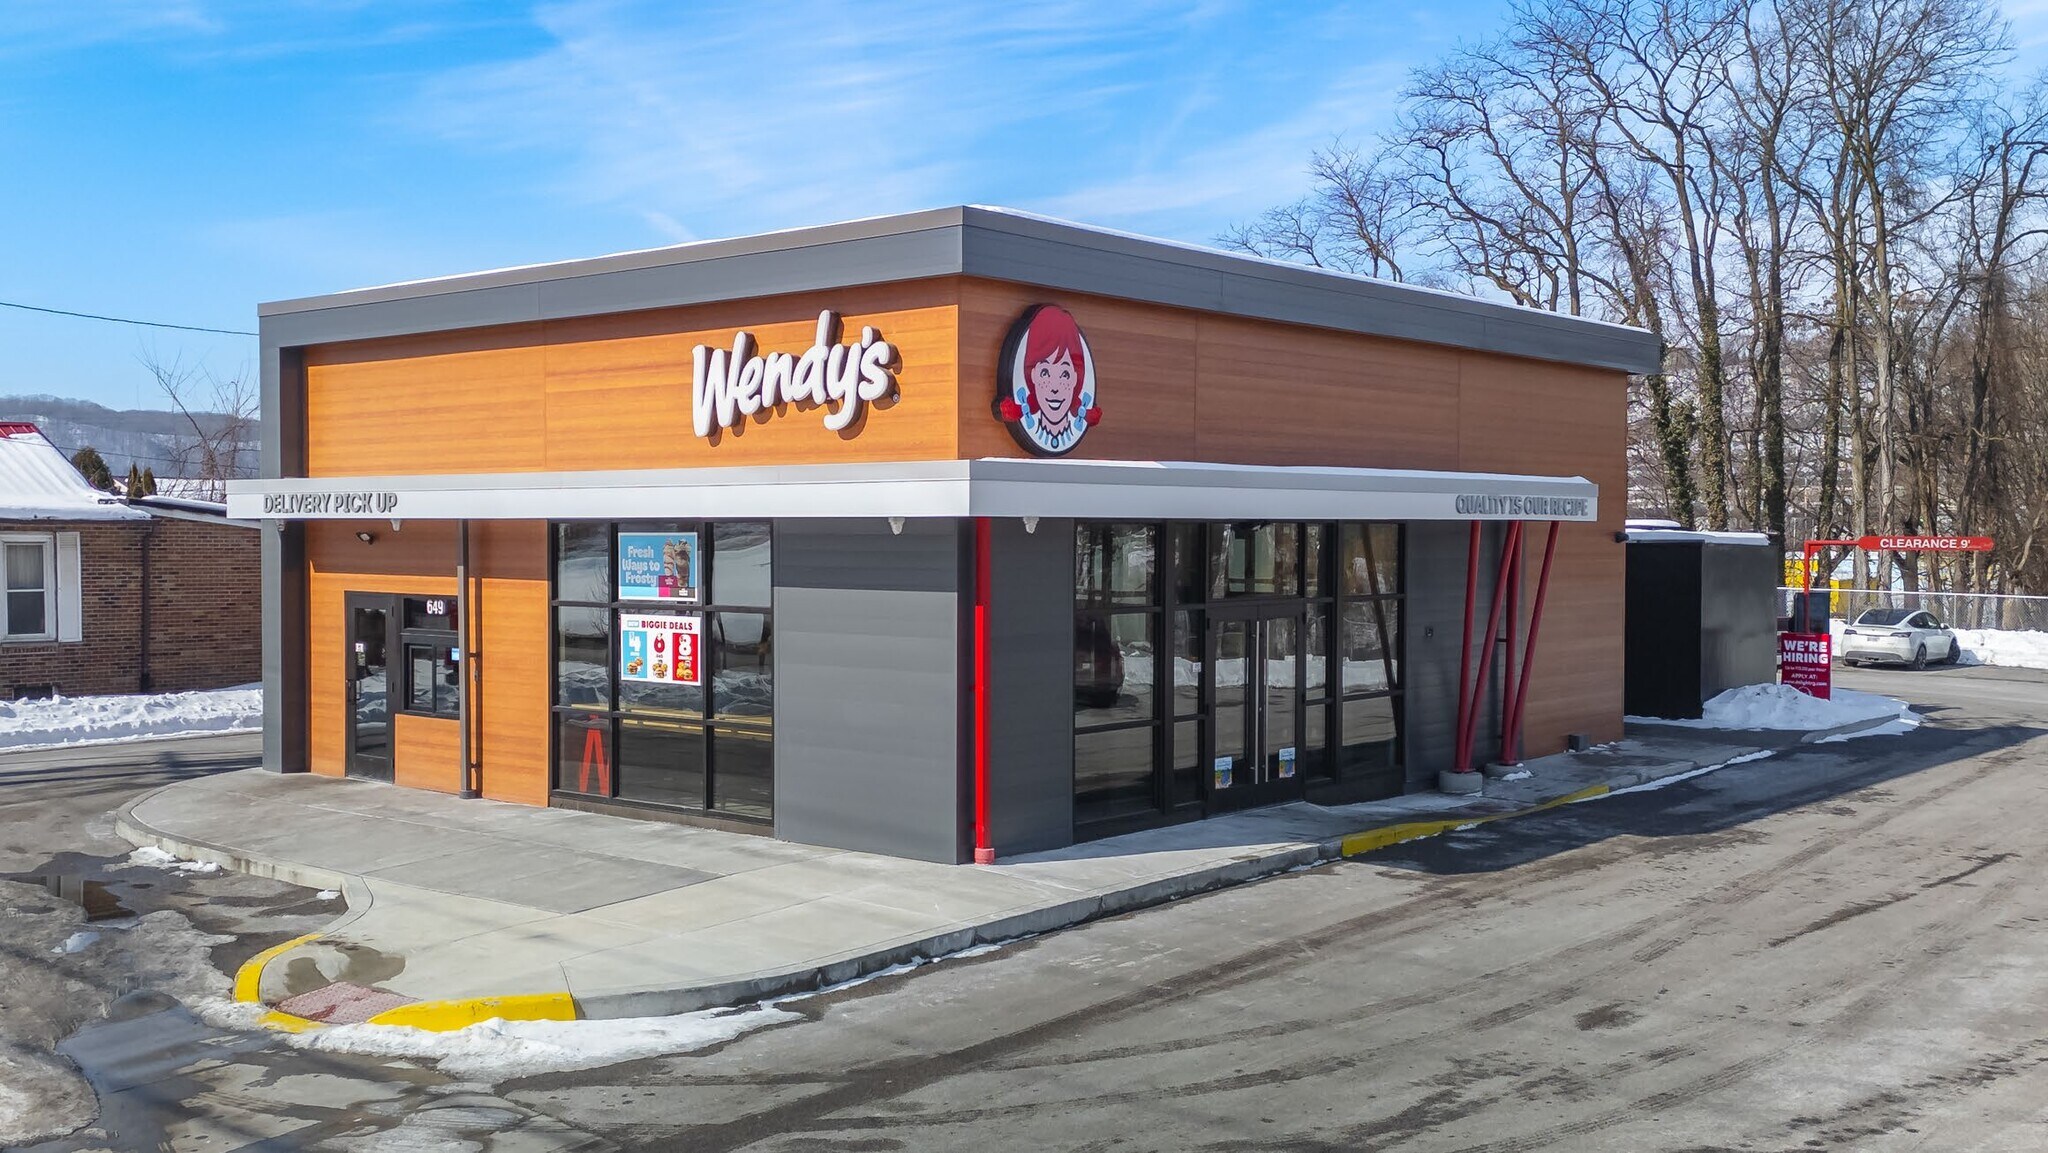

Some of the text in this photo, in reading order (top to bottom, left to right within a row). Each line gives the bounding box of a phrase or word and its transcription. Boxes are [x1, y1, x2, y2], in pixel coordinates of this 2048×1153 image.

[692, 309, 891, 437] Wendy's
[263, 492, 398, 513] DELIVERY PICK UP
[1455, 494, 1588, 516] QUALITY IS OUR RECIPE
[1879, 538, 1957, 549] CLEARANCE
[627, 545, 654, 558] Fresh
[622, 559, 660, 574] Ways to
[625, 571, 657, 587] Frosty
[426, 600, 444, 615] 649
[641, 620, 667, 629] BIGGIE
[669, 622, 693, 631] DEALS
[1783, 640, 1828, 653] WE'RE
[1782, 652, 1829, 664] HIRING
